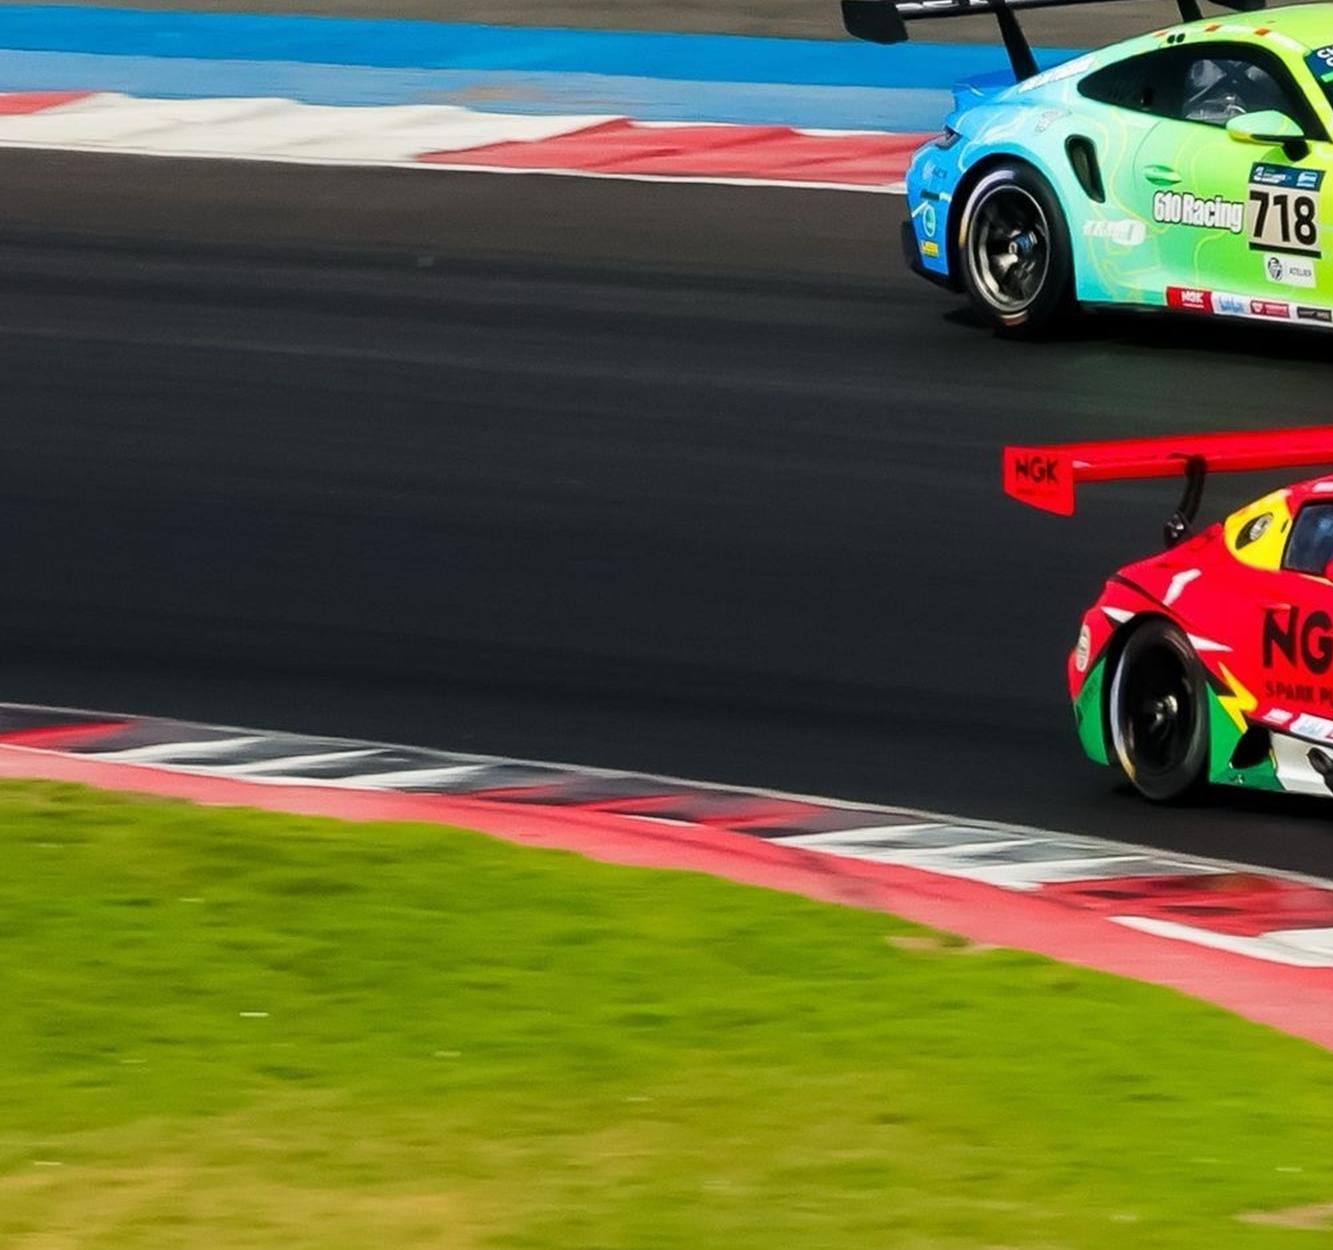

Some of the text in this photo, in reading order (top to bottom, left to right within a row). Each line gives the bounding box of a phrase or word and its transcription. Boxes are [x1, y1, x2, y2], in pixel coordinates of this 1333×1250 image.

[1153, 190, 1182, 223] 610
[1182, 191, 1244, 234] Racing
[1250, 190, 1318, 246] 718
[1015, 456, 1060, 485] NGK
[1264, 679, 1315, 704] SPARK
